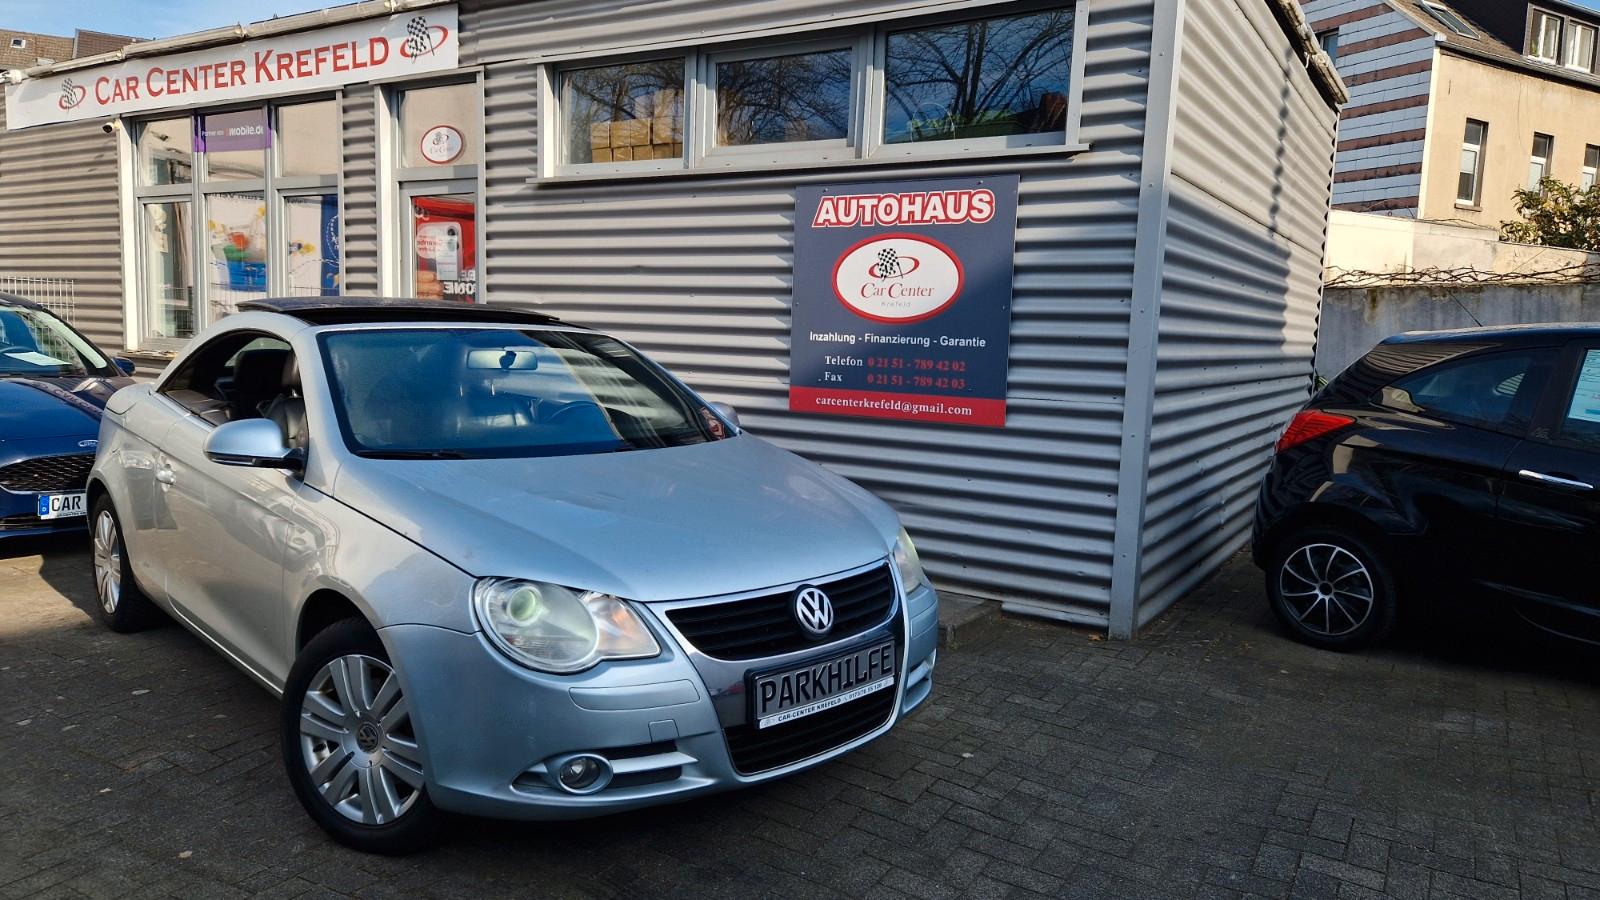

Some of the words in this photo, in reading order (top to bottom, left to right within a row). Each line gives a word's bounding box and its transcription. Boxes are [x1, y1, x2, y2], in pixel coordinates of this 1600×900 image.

[813, 189, 995, 227] AUTOHAUS
[861, 282, 886, 298] Car
[888, 282, 934, 298] Center
[809, 331, 856, 345] Inzahlung
[864, 333, 930, 347] Finanzierung
[940, 336, 986, 347] Garantie
[825, 355, 863, 367] Telefon
[914, 359, 933, 370] 789
[825, 371, 842, 382] Fax
[913, 376, 933, 387] 789
[815, 397, 972, 415] carcenterkrefeld@gmail.com
[51, 495, 81, 511] CAR
[760, 644, 892, 713] PARKHILFE
